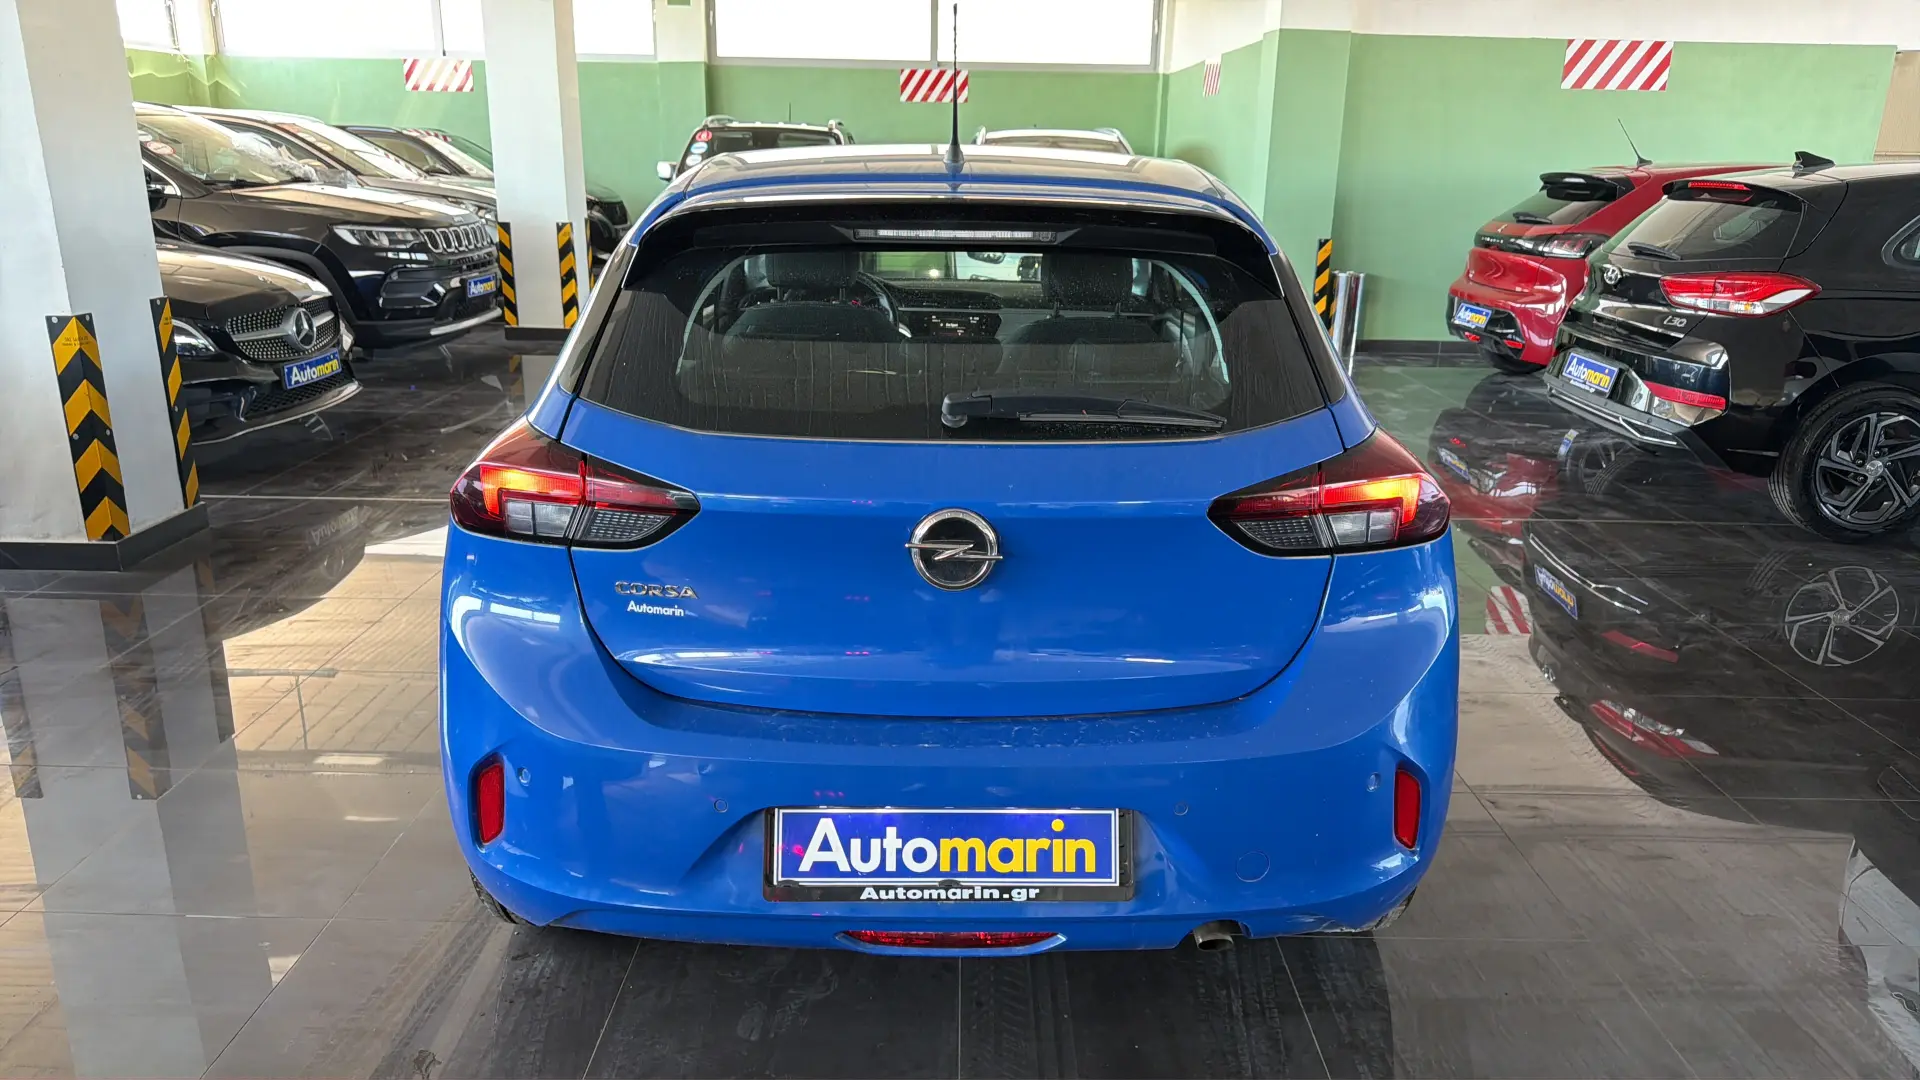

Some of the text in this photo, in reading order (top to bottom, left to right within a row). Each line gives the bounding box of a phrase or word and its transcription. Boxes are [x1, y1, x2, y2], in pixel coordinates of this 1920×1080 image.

[291, 354, 339, 385] Automarin
[1566, 357, 1611, 388] Automarin
[615, 581, 699, 600] CORSA
[627, 600, 684, 617] Automarin
[798, 817, 1096, 873] Automarin
[859, 885, 1041, 901] Automarin.gr
